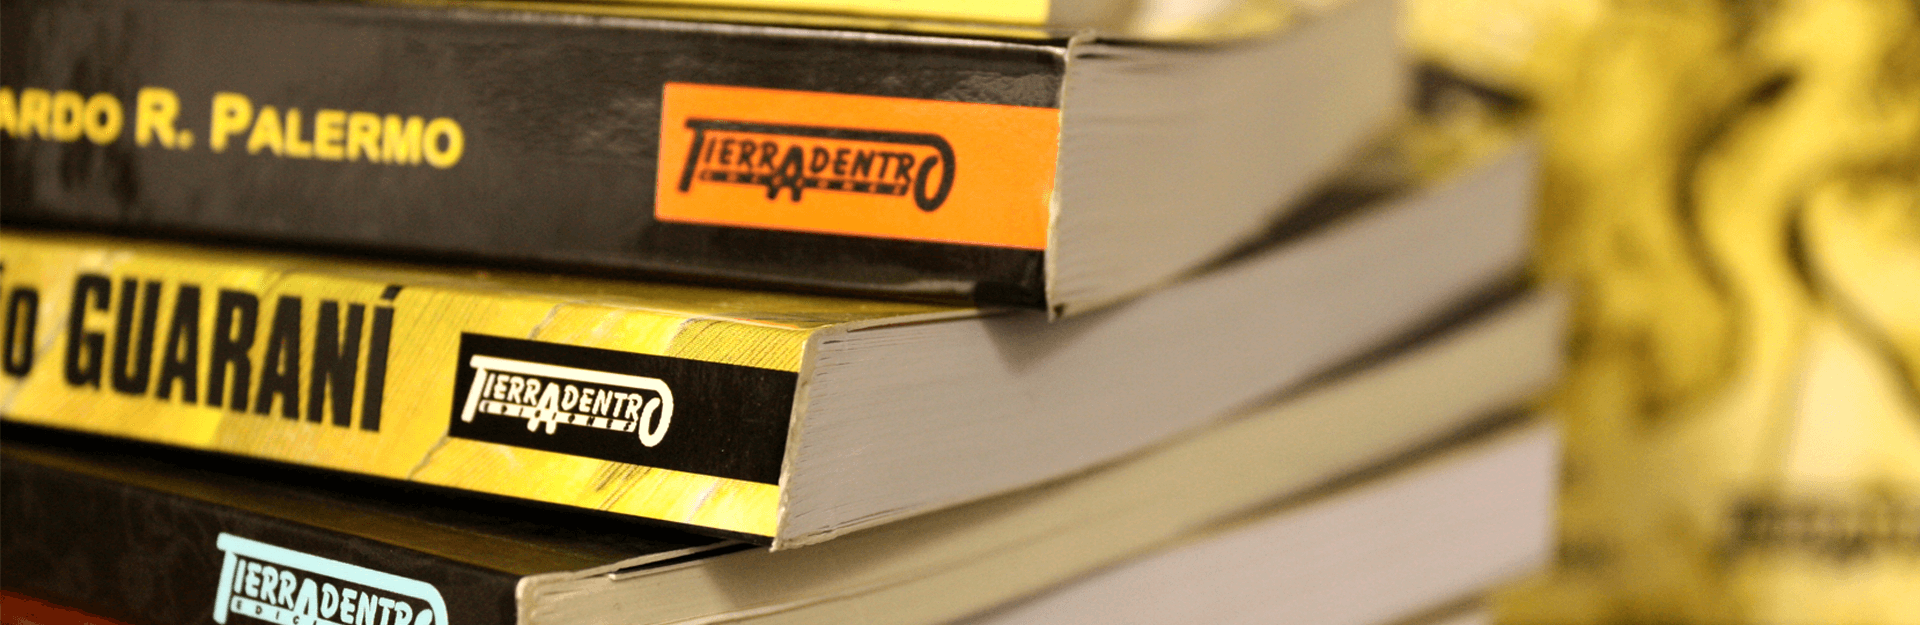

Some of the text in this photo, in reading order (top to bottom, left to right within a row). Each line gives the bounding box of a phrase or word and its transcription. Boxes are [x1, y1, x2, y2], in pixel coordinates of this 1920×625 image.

[135, 87, 194, 150] R.
[209, 91, 465, 168] PALERMO
[677, 117, 956, 212] TIERRADENTRO
[64, 273, 402, 432] GUARANÍ
[460, 354, 674, 447] TIERRADENTRO
